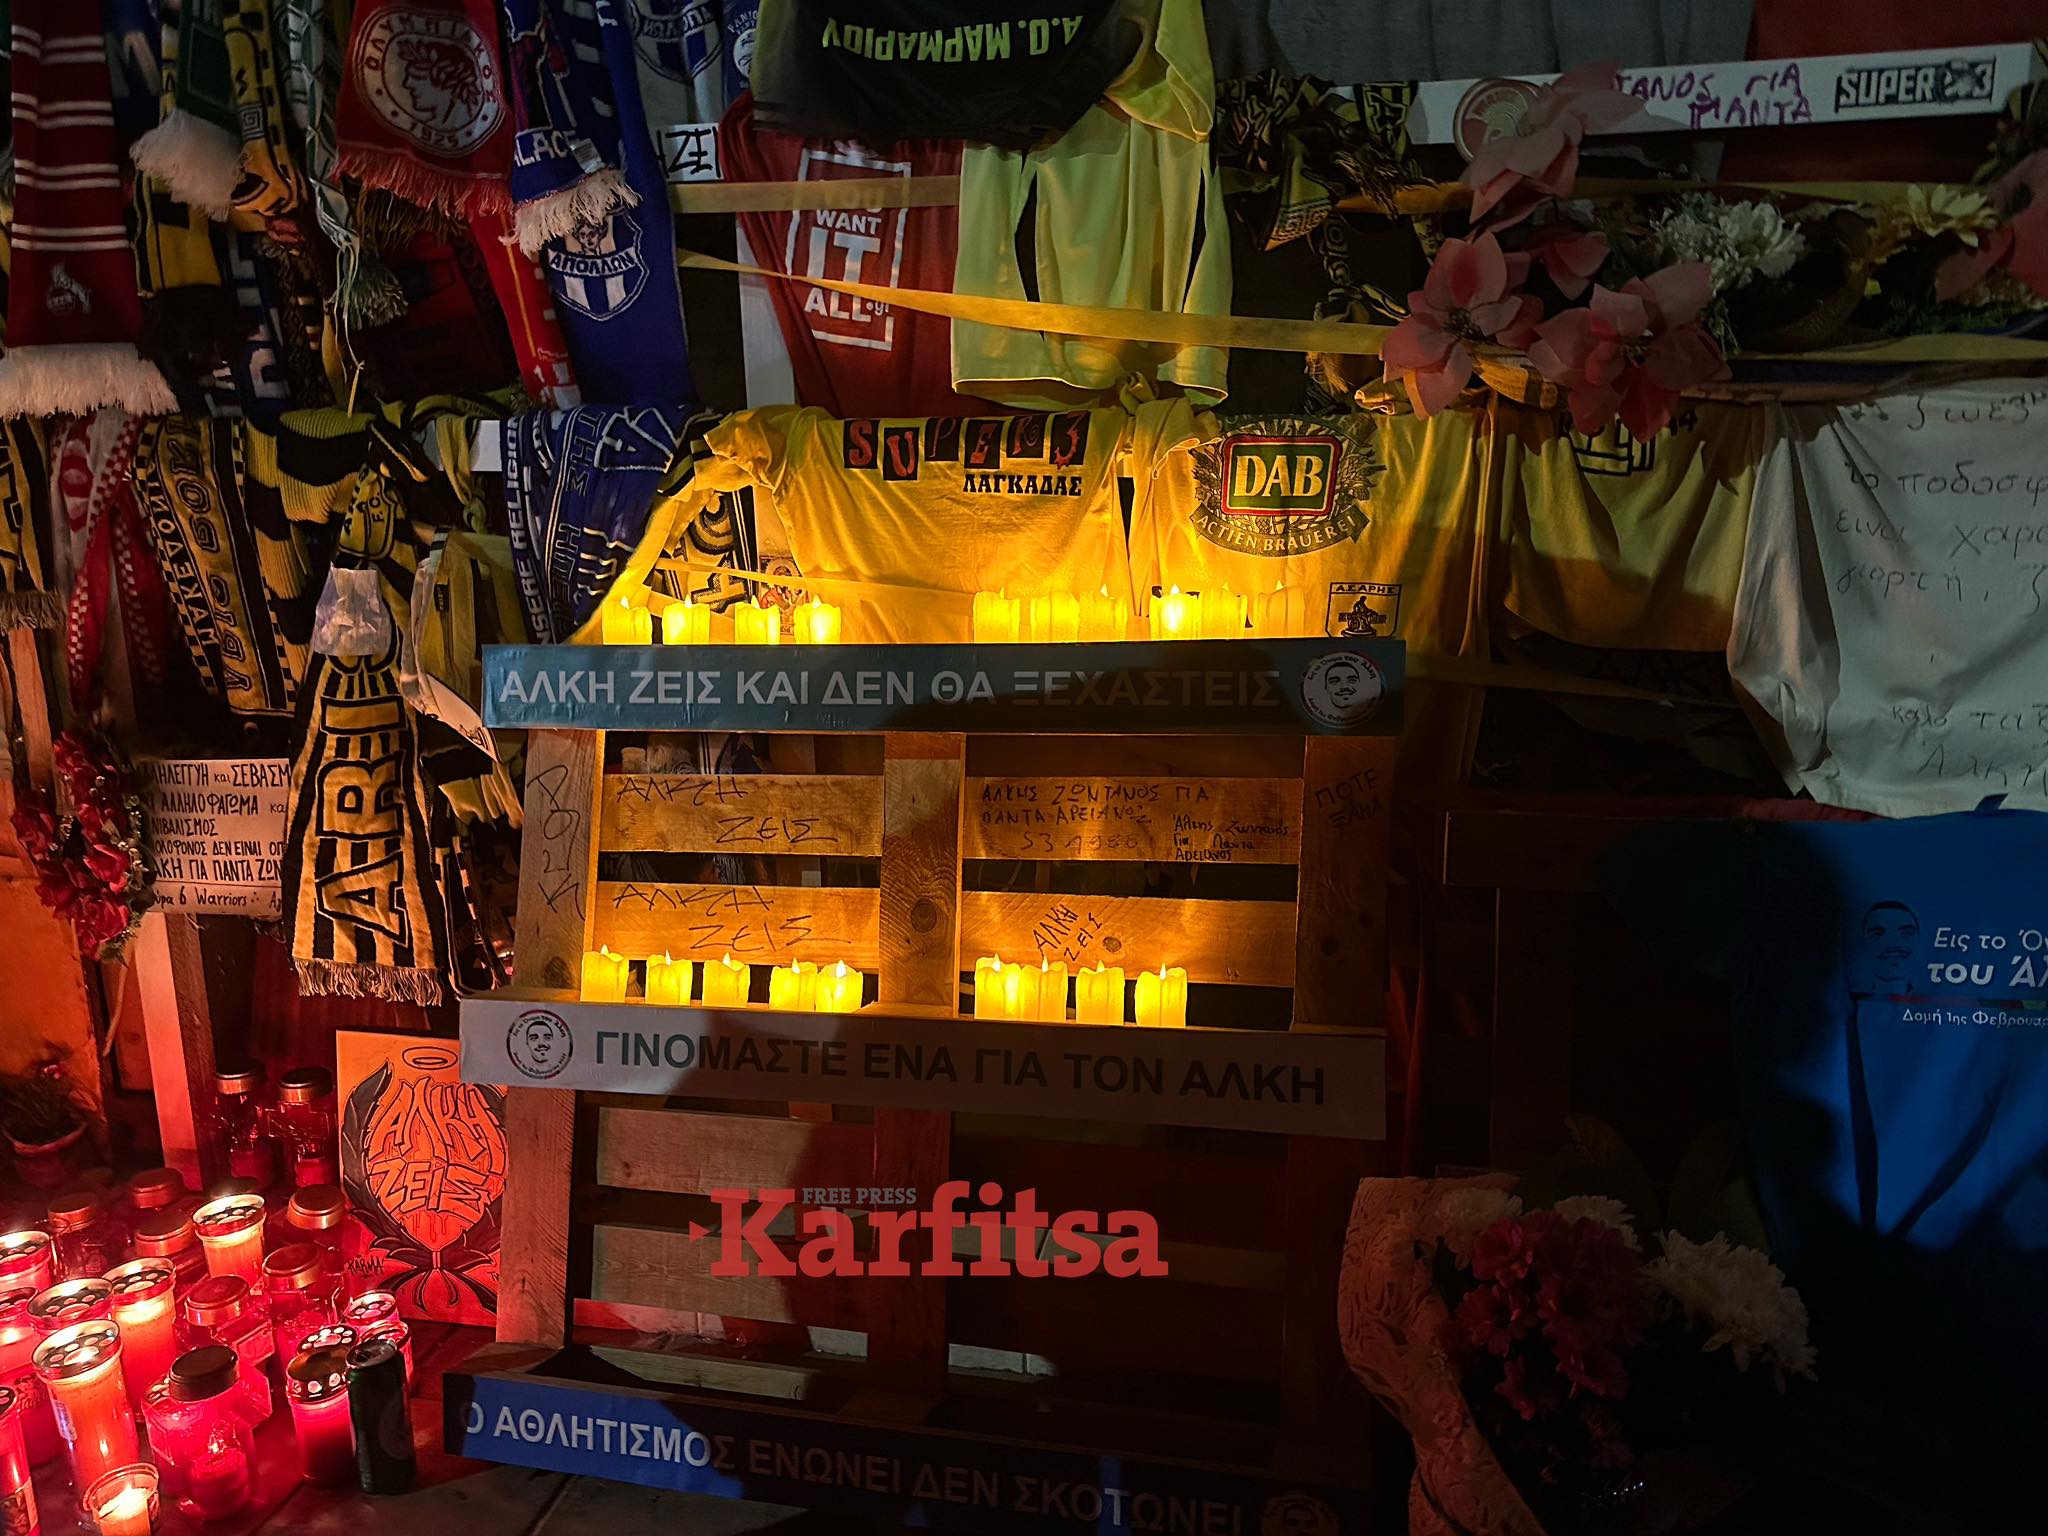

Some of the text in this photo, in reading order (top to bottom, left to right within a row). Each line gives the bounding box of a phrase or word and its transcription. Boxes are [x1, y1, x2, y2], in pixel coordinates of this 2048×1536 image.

[821, 17, 1011, 63] ΜΑΡΜΑΡΙΟΥ
[1838, 66, 1937, 107] SUPER
[408, 119, 459, 149] 1925
[815, 208, 883, 236] WANT
[550, 250, 637, 277] ΑΠΟΛΛΩΝ
[806, 225, 882, 285] IT
[963, 474, 1082, 497] ΛΑΓΚΑΔΑΣ
[1232, 454, 1325, 498] DAB
[1196, 513, 1358, 551] ACTIEN BRAUEREI
[500, 670, 1280, 707] ΑΛΚΗ ΖΕΙΣ ΚΑΙ ΔΕΝ ΘΑ ΞΕΧΑΣΤΕΙΣ
[1050, 783, 1161, 805] ΖΩΝΤΑΝΟΣ
[981, 808, 1044, 826] ΠΑΝΤΑ
[212, 841, 234, 857] ΔΕΝ
[234, 841, 263, 857] ΕΙΝΑΙ
[189, 858, 209, 881] ΓΙΑ
[212, 859, 254, 882] ΠΑΝΤΑ
[195, 886, 248, 907] Warriors
[1031, 903, 1081, 953] ΑΛΚΗ
[1933, 926, 1971, 952] Εις
[1977, 932, 2007, 950] το
[1927, 962, 1996, 986] του
[595, 1031, 848, 1076] ΓΙΝΟΜΑΣΤΕ
[863, 1042, 958, 1083] ΕΝΑ
[974, 1047, 1049, 1088] ΓΙΑ
[1063, 1053, 1163, 1096] ΤΟΝ
[1179, 1061, 1325, 1105] ΑΛΚΗ
[367, 1075, 507, 1176] ΑΛΚΗ
[369, 1158, 493, 1214] ΖΕΙΣ
[493, 1406, 737, 1471] ΑΘΛΗΤΙΣΜΟΣ
[748, 1439, 900, 1495] ΕΝΩΝΕΙ
[912, 1463, 1000, 1509] ΔΕΝ
[1012, 1474, 1241, 1536] ΣΚΟΤΩΝΕΙ
